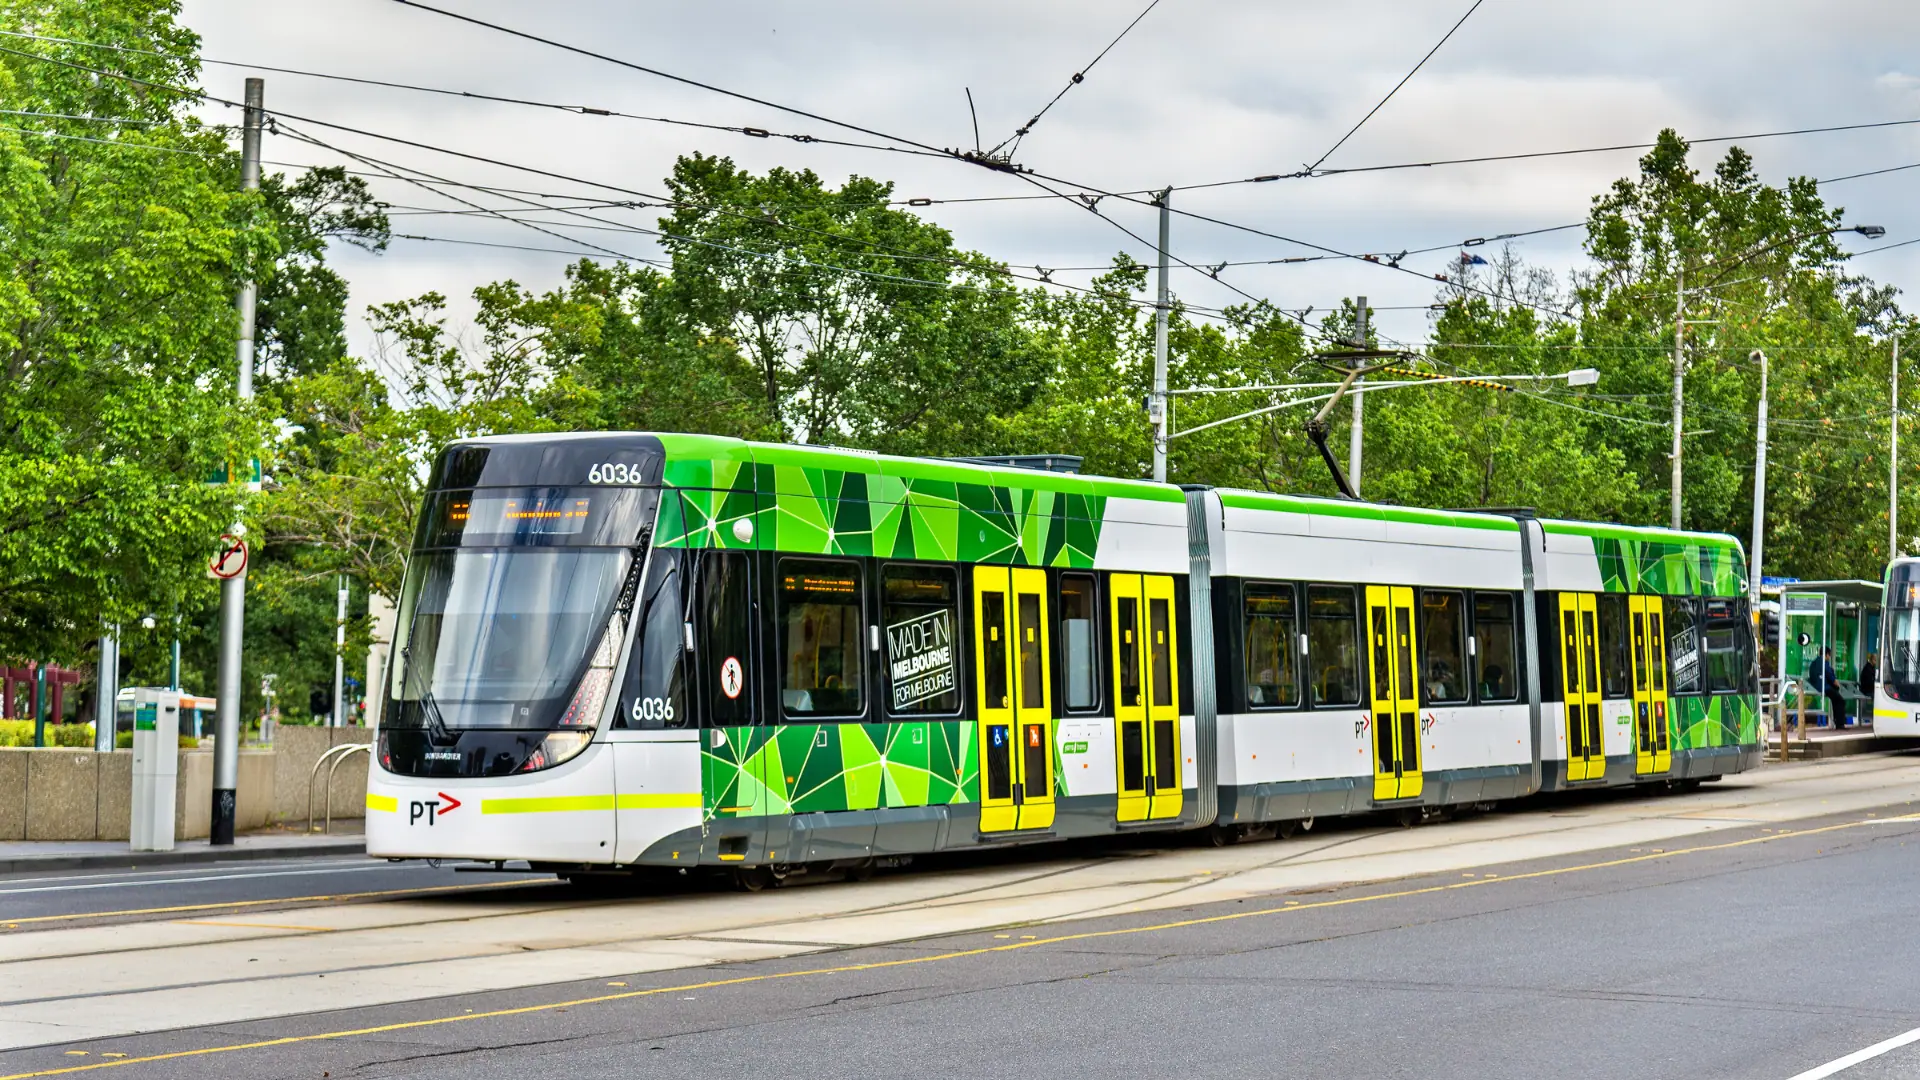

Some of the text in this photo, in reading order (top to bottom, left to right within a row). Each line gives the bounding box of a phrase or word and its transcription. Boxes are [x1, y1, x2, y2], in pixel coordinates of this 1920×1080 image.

[588, 463, 642, 484] 6036
[889, 614, 949, 661] MADE IN
[892, 646, 950, 681] MELBOURNE
[895, 671, 953, 705] FOR MELBOURNE
[632, 697, 674, 720] 6036
